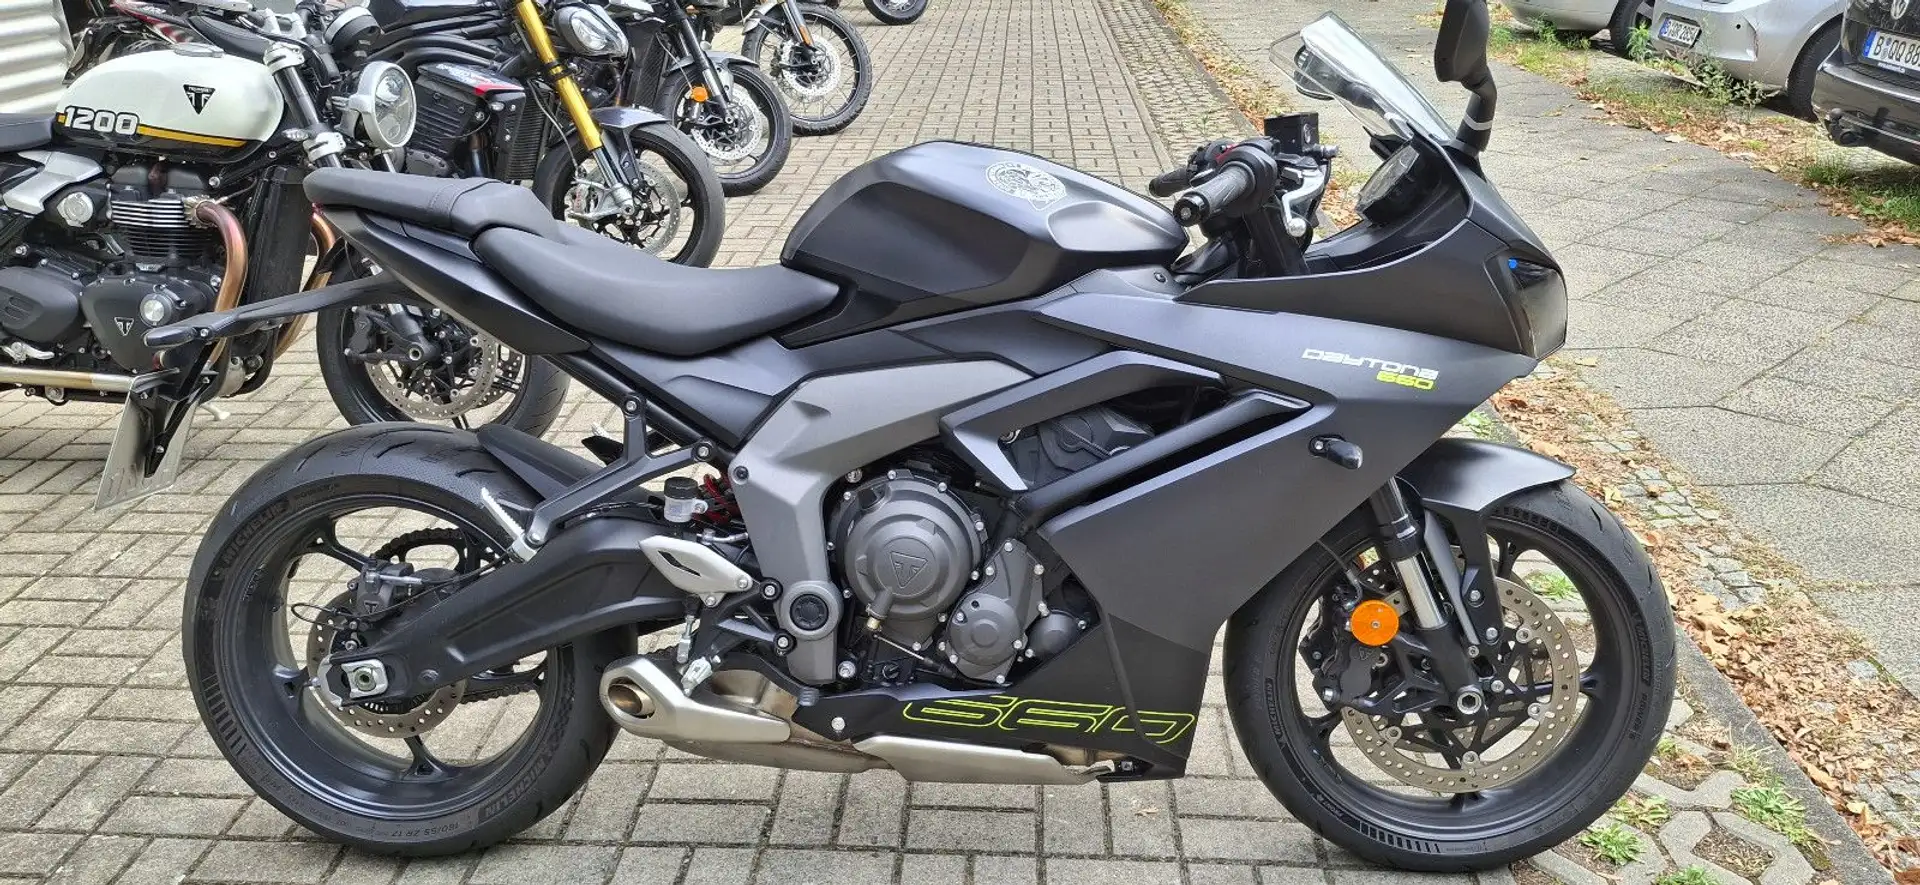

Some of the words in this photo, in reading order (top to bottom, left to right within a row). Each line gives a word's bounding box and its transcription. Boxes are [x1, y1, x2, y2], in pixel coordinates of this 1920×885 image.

[1873, 36, 1885, 56] B
[1888, 39, 1906, 62] QQ
[1904, 43, 1920, 67] 88
[64, 106, 138, 136] 1200
[1376, 370, 1434, 390] 660
[221, 502, 287, 569] MICHELIN
[903, 696, 1195, 743] 660
[1265, 681, 1282, 738] MICHELIN
[484, 757, 550, 819] MICHELIN
[424, 822, 460, 836] 160/55
